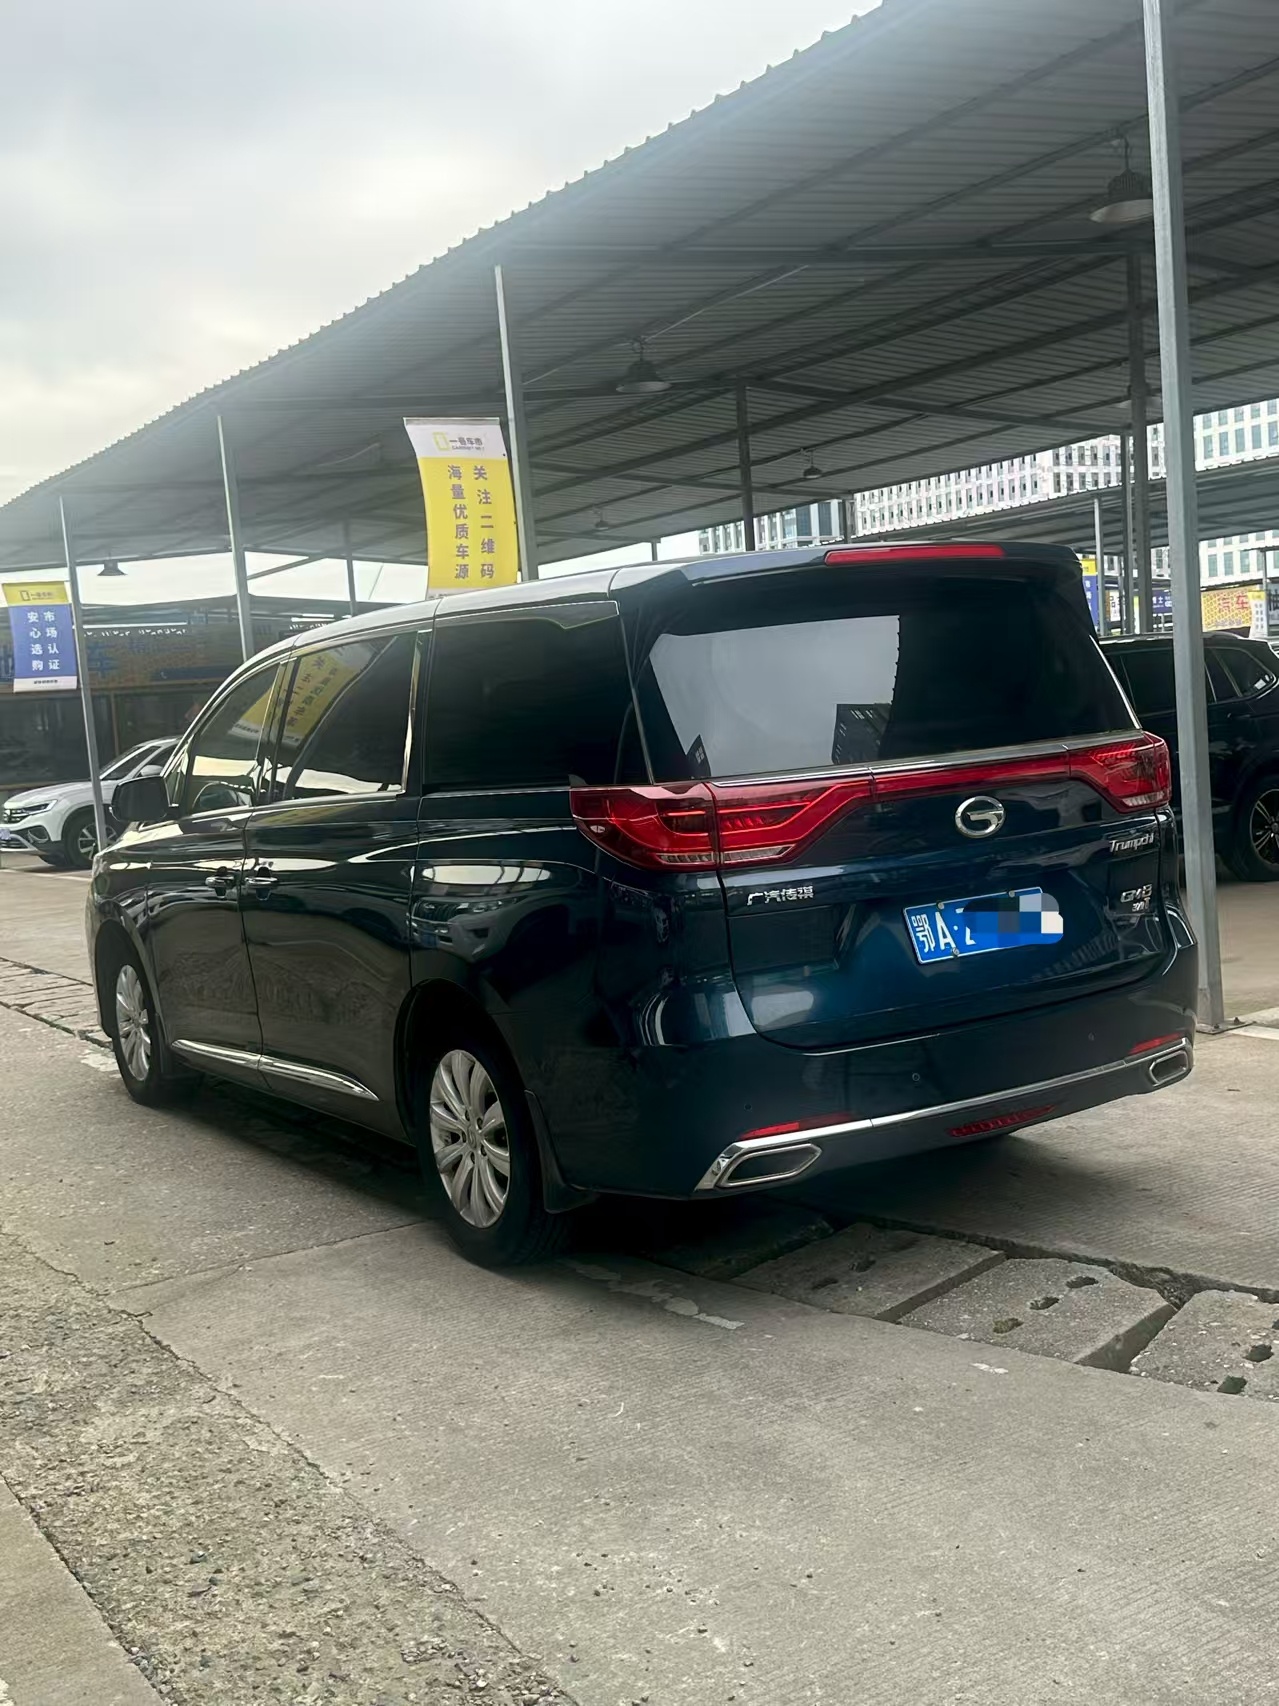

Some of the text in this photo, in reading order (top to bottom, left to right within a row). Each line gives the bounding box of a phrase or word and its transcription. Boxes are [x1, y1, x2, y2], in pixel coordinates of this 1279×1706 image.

[447, 464, 469, 579] 海量优质车源
[473, 465, 495, 579] 关注二维码
[27, 611, 43, 671] 安心选购
[43, 611, 60, 670] 市场认证
[747, 886, 813, 906] 广汽传祺
